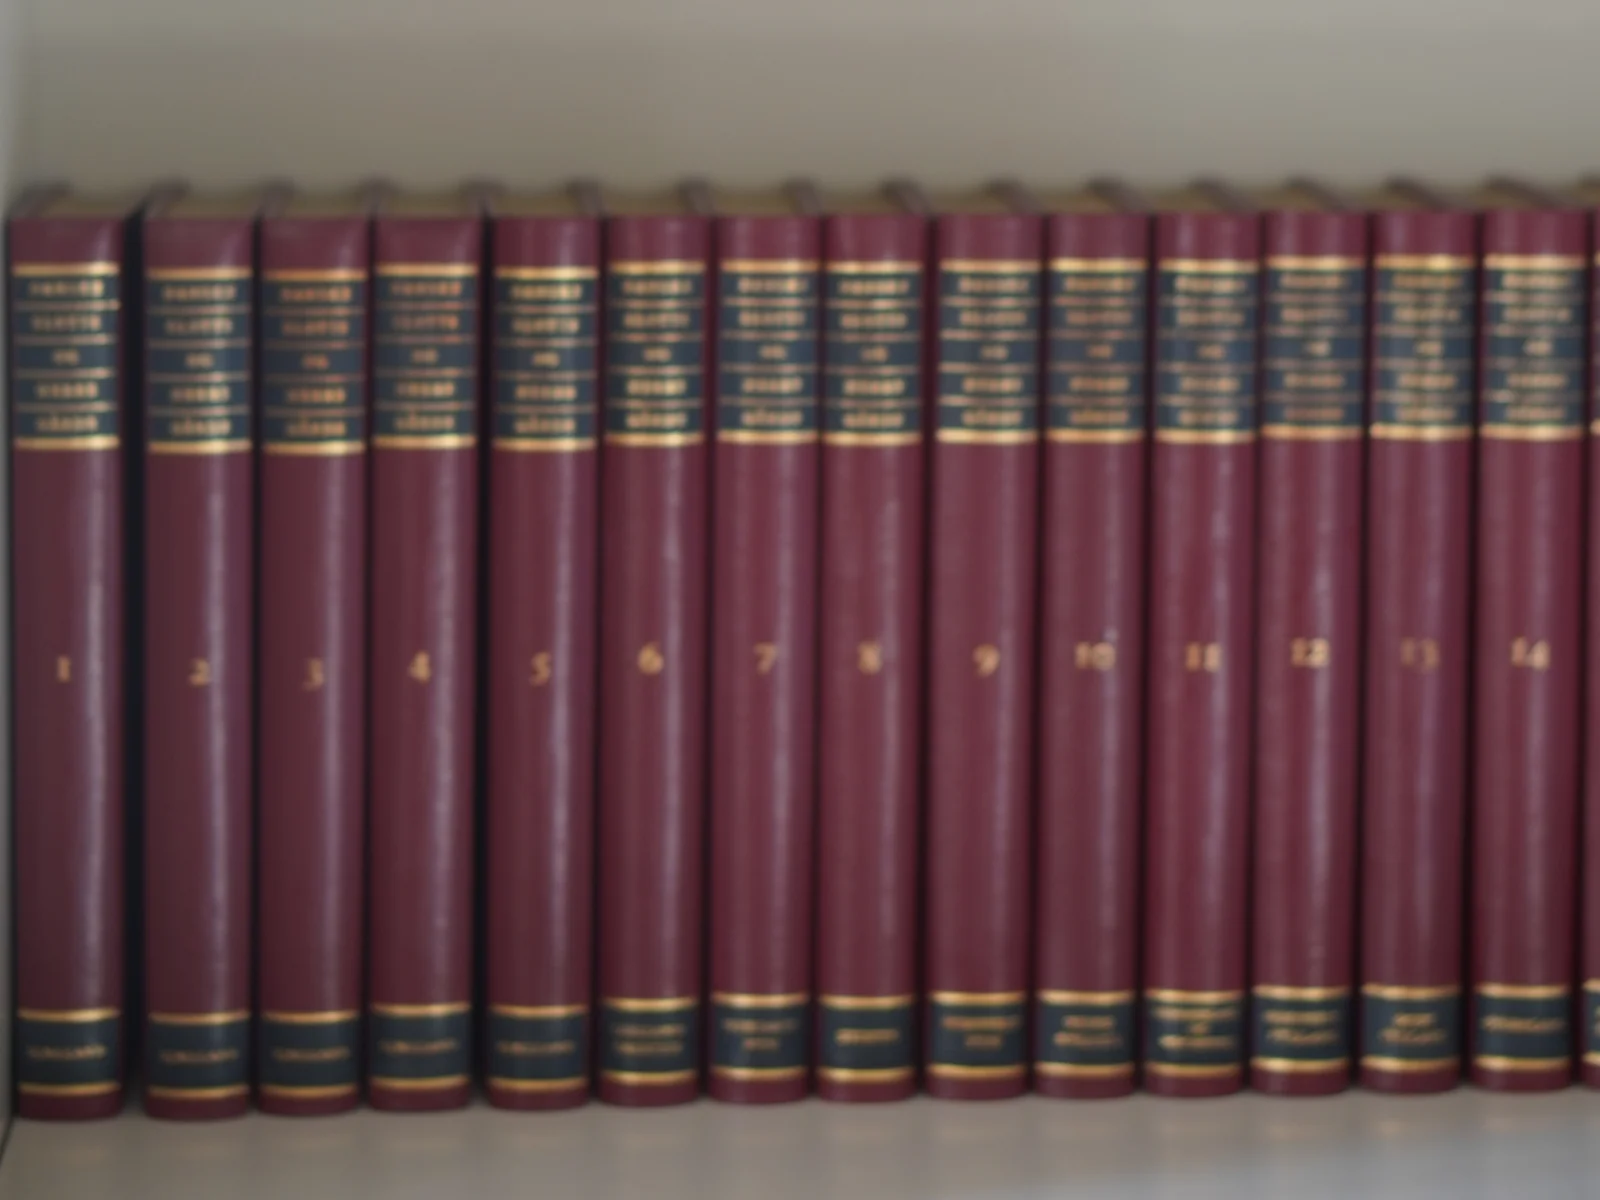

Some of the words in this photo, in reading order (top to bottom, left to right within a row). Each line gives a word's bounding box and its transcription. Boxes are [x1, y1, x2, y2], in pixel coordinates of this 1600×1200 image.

[187, 657, 212, 687] 2
[409, 651, 432, 682] 4
[530, 651, 551, 686] 5
[637, 644, 665, 675] 6
[754, 642, 778, 673] 7
[972, 643, 1000, 678] 9
[1074, 641, 1116, 672] 10
